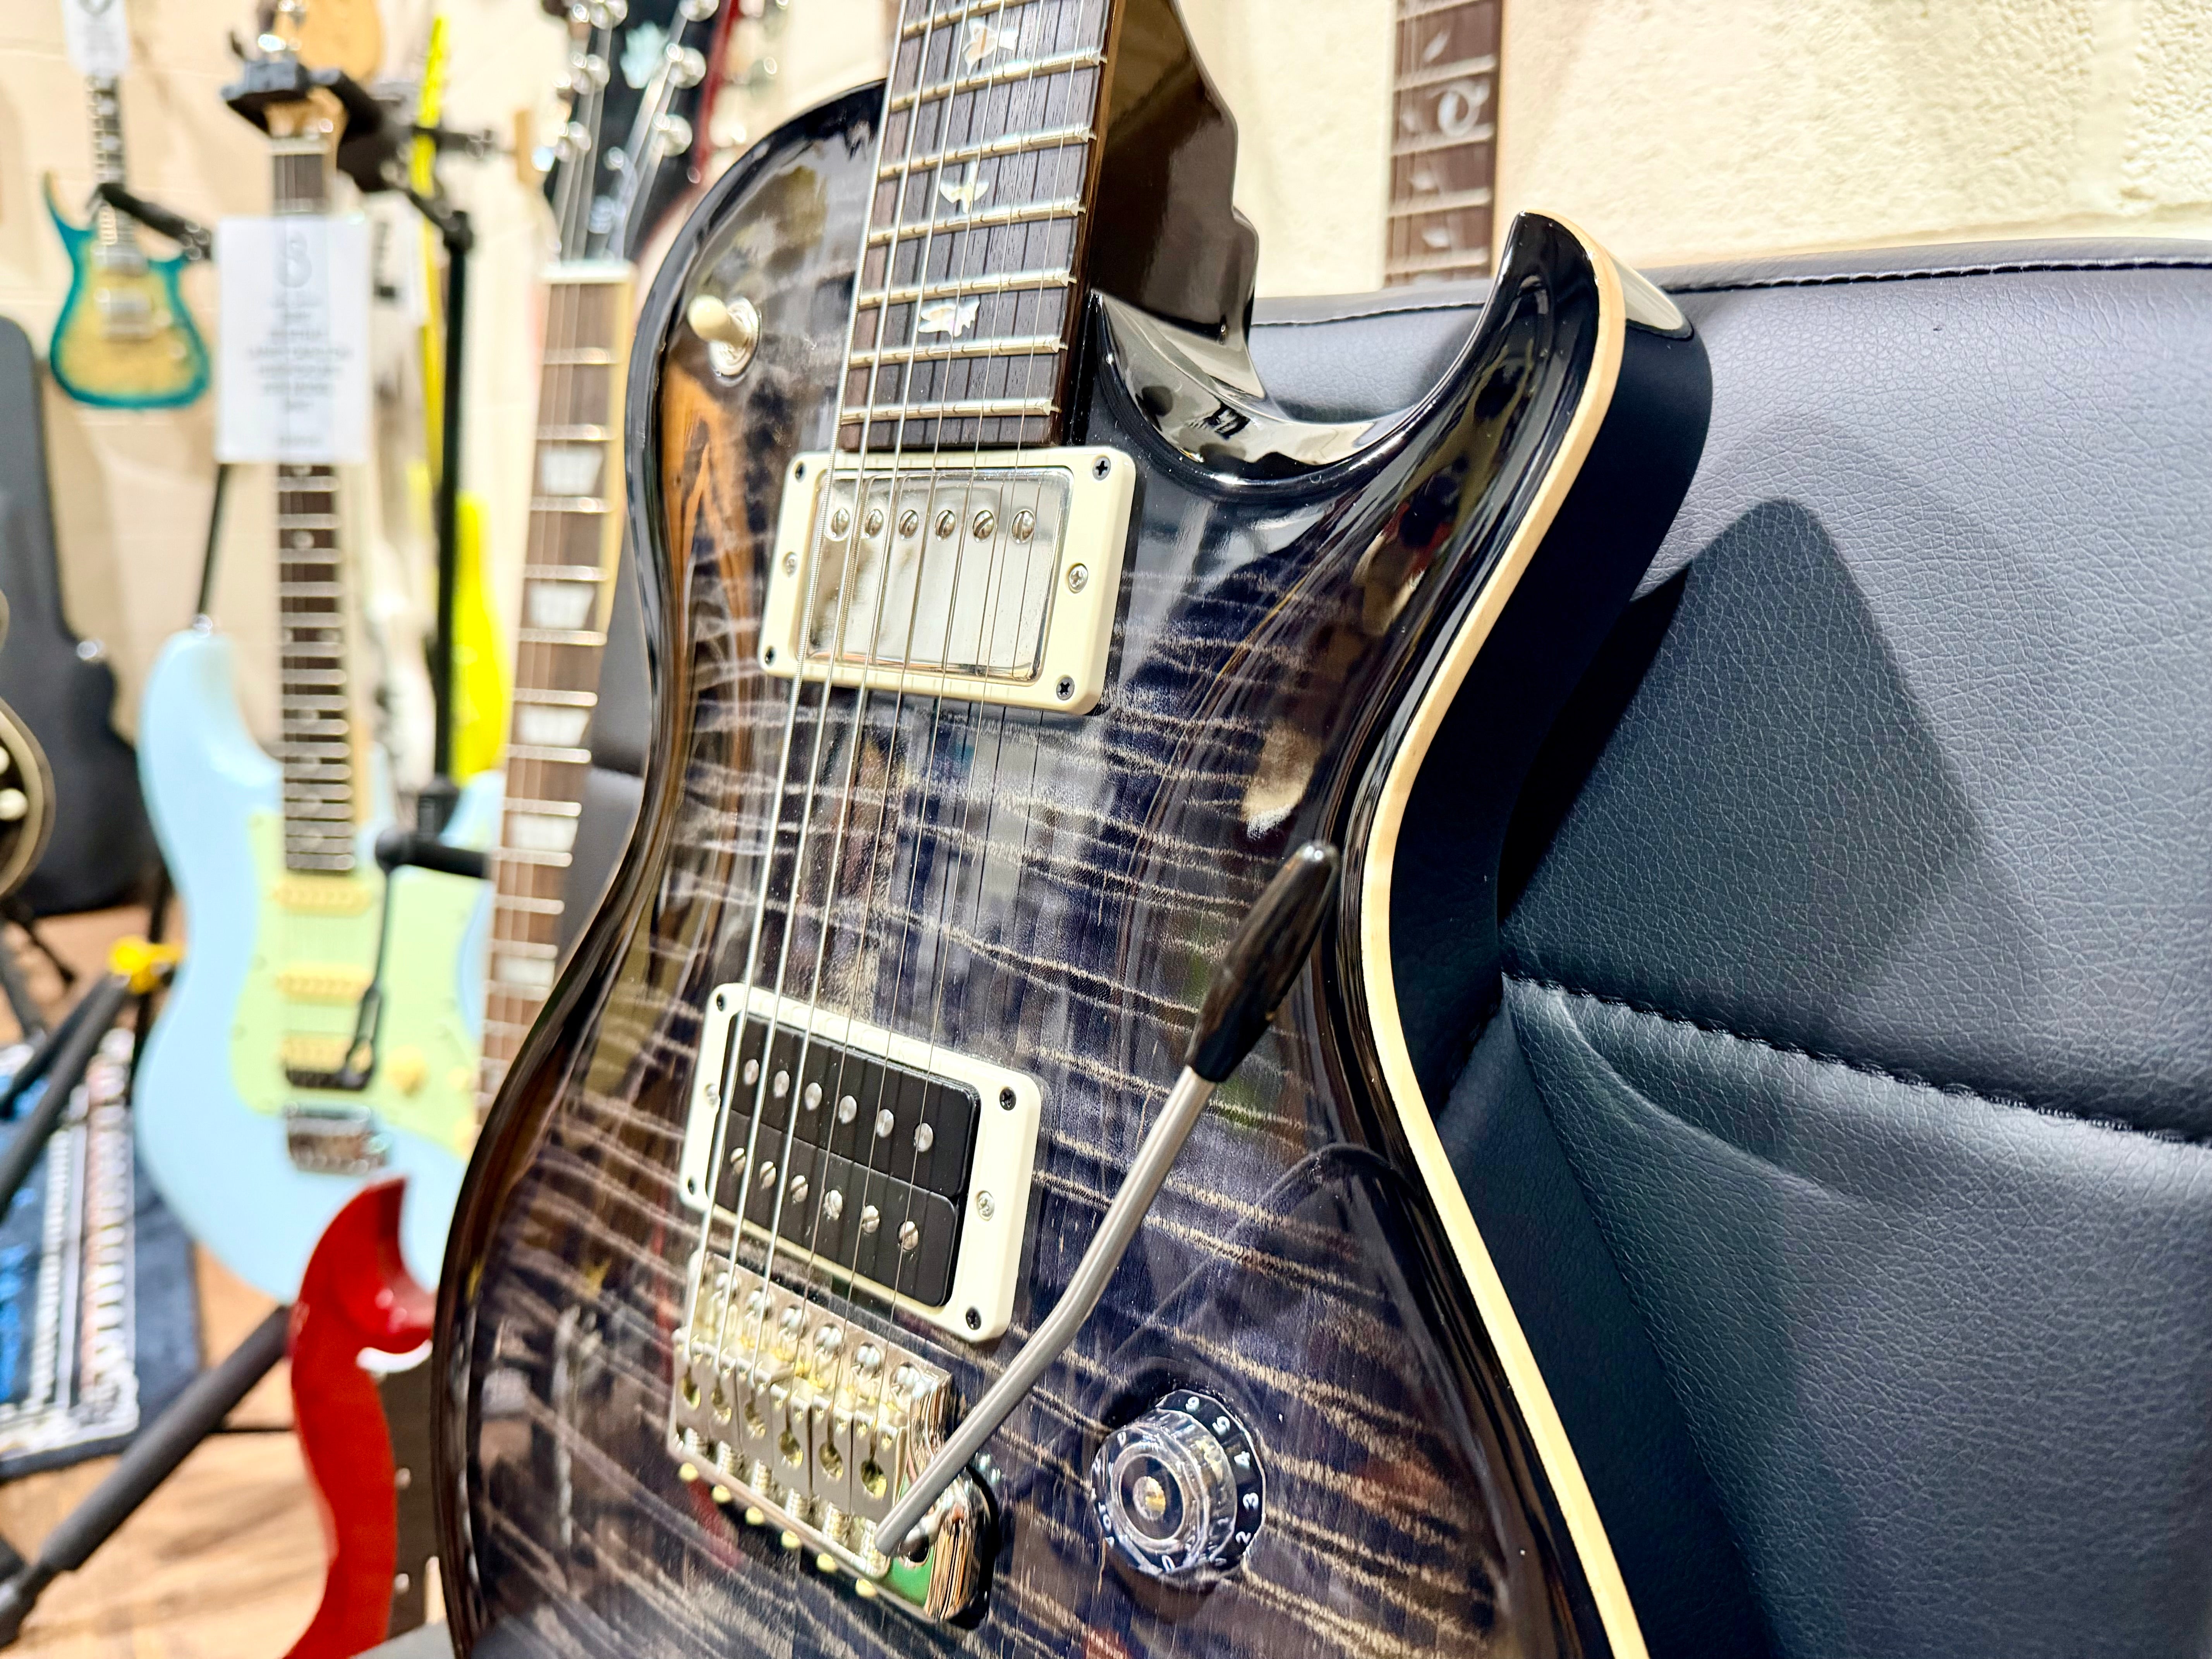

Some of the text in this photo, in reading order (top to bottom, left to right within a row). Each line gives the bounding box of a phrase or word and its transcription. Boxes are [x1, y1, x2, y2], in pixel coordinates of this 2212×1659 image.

[1212, 1416, 1230, 1435] 5
[1234, 1451, 1250, 1469] 4
[1243, 1492, 1259, 1510] 3
[1235, 1531, 1251, 1544] 2
